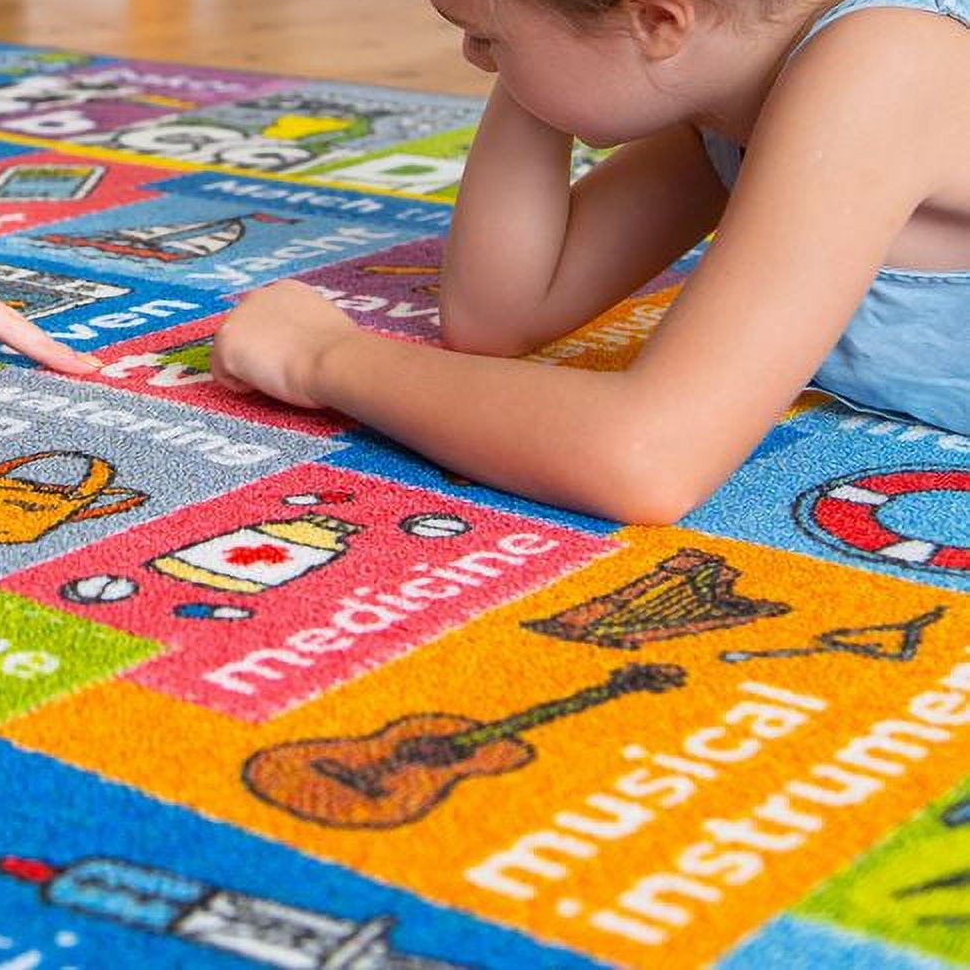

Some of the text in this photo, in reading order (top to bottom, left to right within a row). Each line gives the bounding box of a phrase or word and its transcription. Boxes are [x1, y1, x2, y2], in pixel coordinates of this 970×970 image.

[15, 299, 203, 349] ven
[200, 530, 560, 698] medicine
[464, 680, 829, 901] musical
